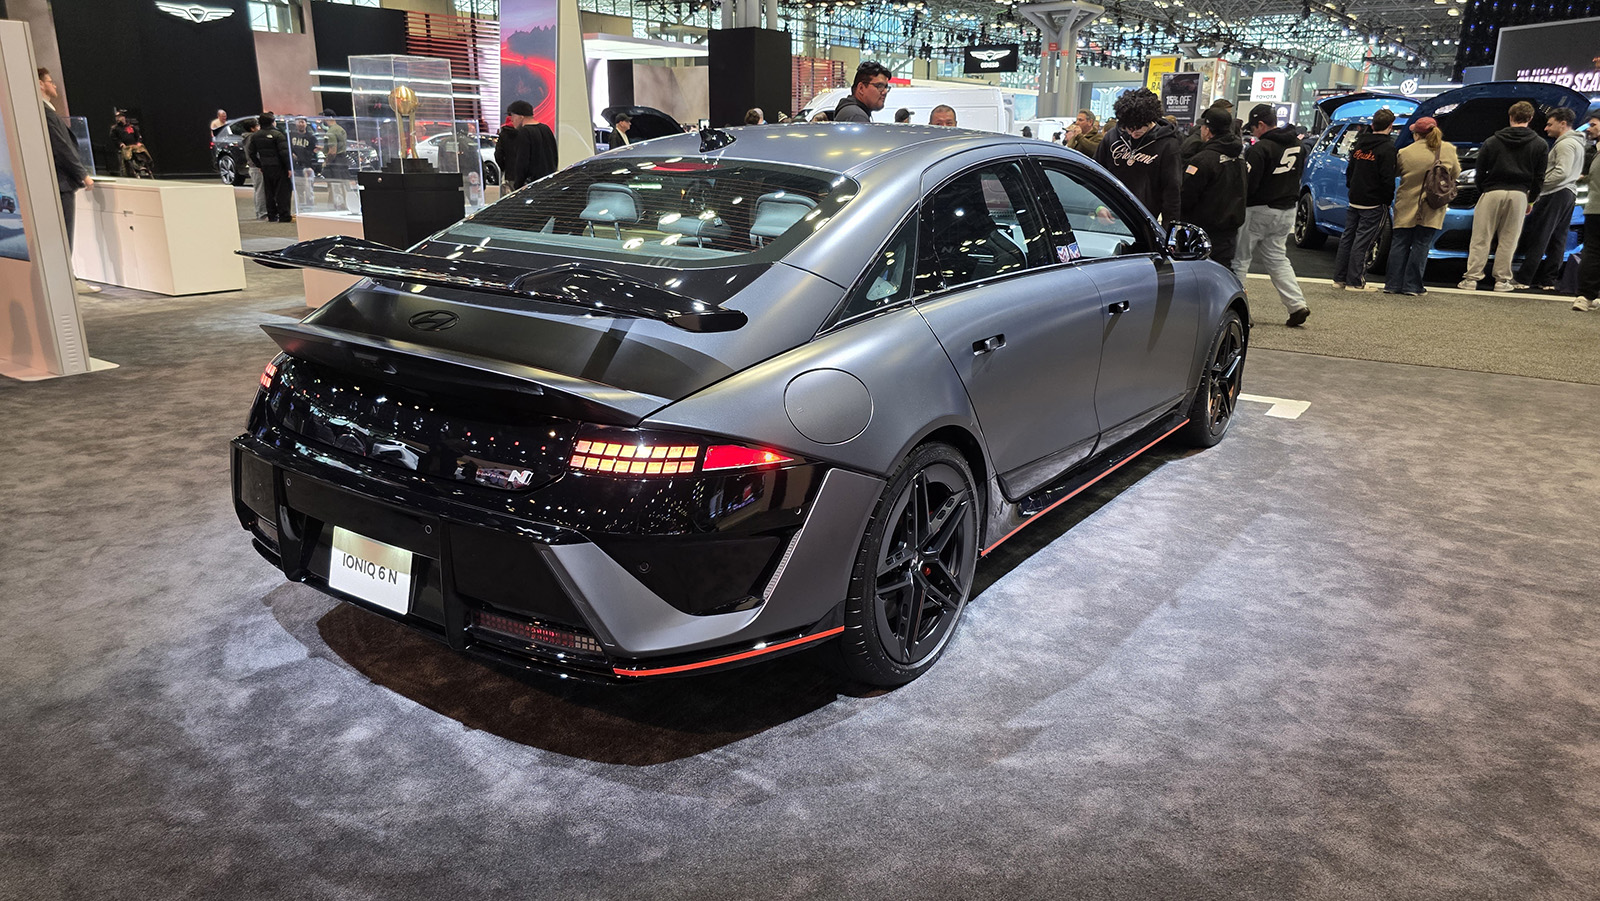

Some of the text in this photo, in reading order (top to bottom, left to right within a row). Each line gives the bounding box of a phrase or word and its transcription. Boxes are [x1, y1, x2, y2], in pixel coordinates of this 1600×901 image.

[1166, 95, 1192, 105] 15% OFF
[1272, 146, 1301, 175] 5
[508, 469, 534, 485] N
[342, 553, 398, 585] IONIQ 6 N
